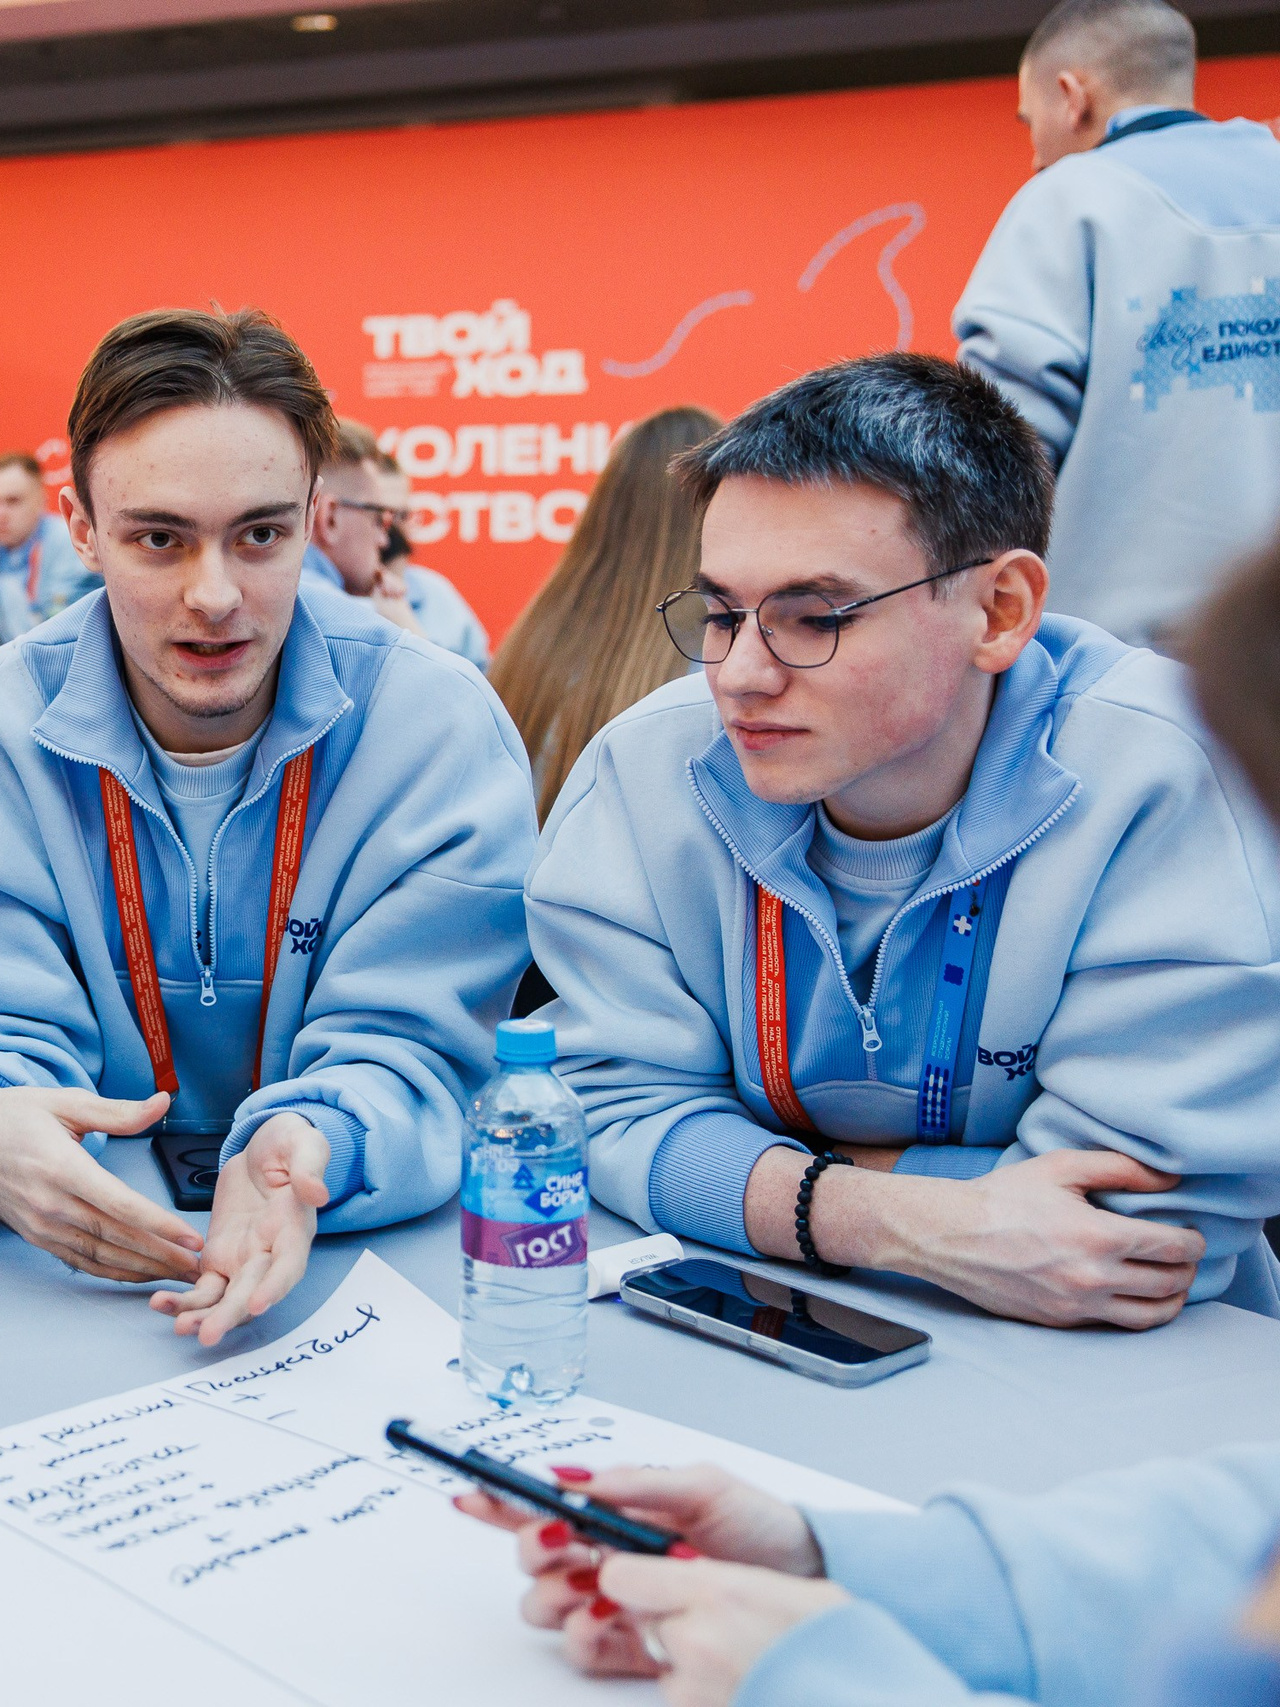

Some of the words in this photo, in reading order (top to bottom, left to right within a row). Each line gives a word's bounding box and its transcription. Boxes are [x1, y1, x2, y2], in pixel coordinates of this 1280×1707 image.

[362, 298, 531, 358] ТВОЙ
[452, 349, 589, 397] ХОД
[377, 421, 628, 478] ОЛЕНИ
[406, 490, 587, 544] СТВО
[761, 994, 770, 1059] ПРЕЕМСТВЕННОСТЬ
[977, 1043, 1038, 1066] ВОЙ
[515, 1224, 572, 1265] ГОСТ
